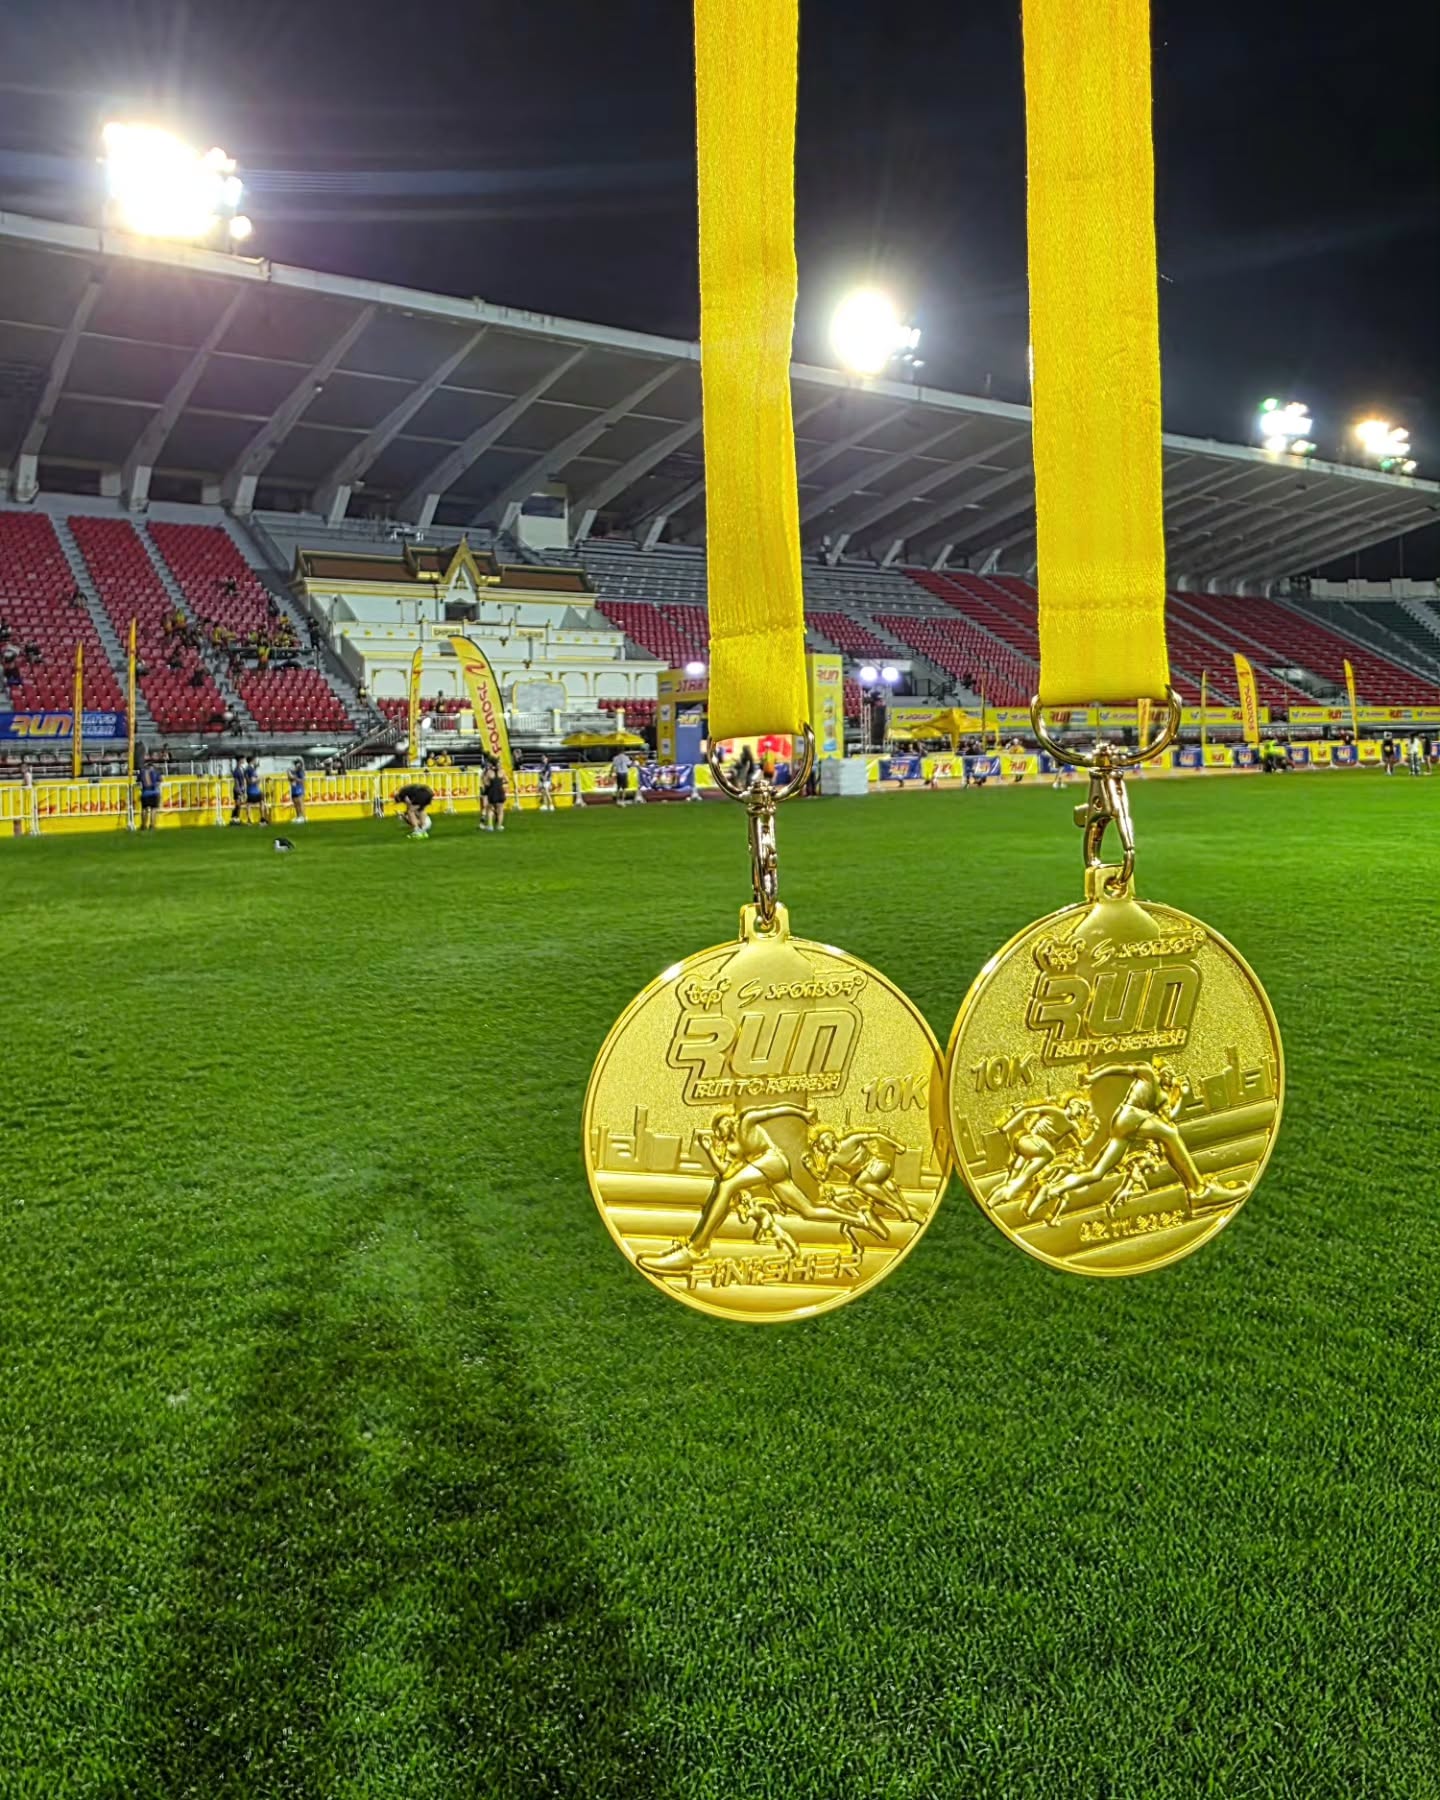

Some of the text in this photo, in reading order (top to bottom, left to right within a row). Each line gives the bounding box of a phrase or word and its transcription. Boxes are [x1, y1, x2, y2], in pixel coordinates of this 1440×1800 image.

[971, 1055, 1034, 1093] 10K
[861, 1075, 929, 1113] 10K
[687, 1253, 863, 1291] FINISHER
